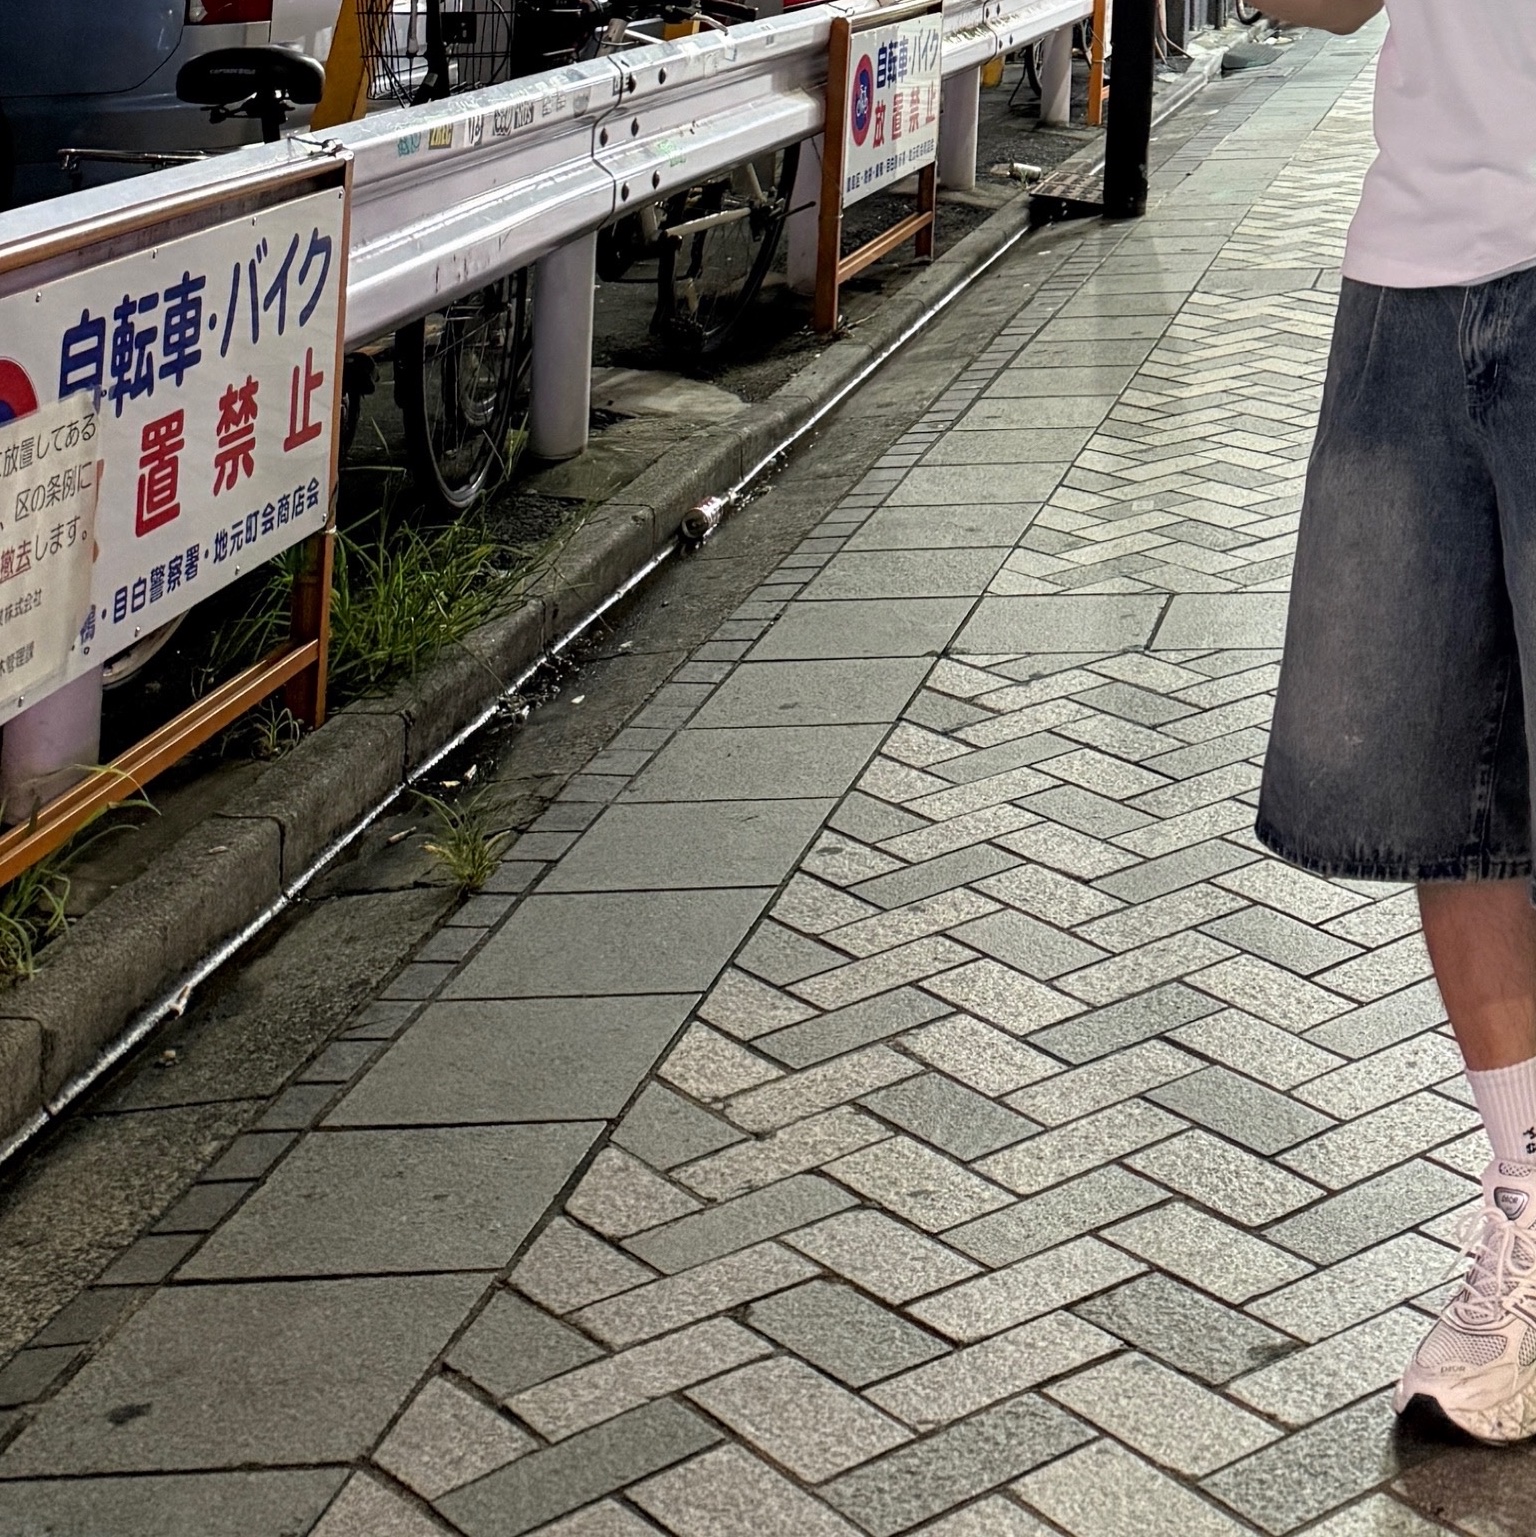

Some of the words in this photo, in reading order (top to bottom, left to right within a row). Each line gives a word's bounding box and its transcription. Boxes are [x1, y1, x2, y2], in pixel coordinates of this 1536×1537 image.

[872, 81, 937, 150] 放置禁止
[58, 226, 333, 418] 自転車・バイク
[0, 413, 97, 478] 放置してある
[97, 347, 325, 562] 置禁止
